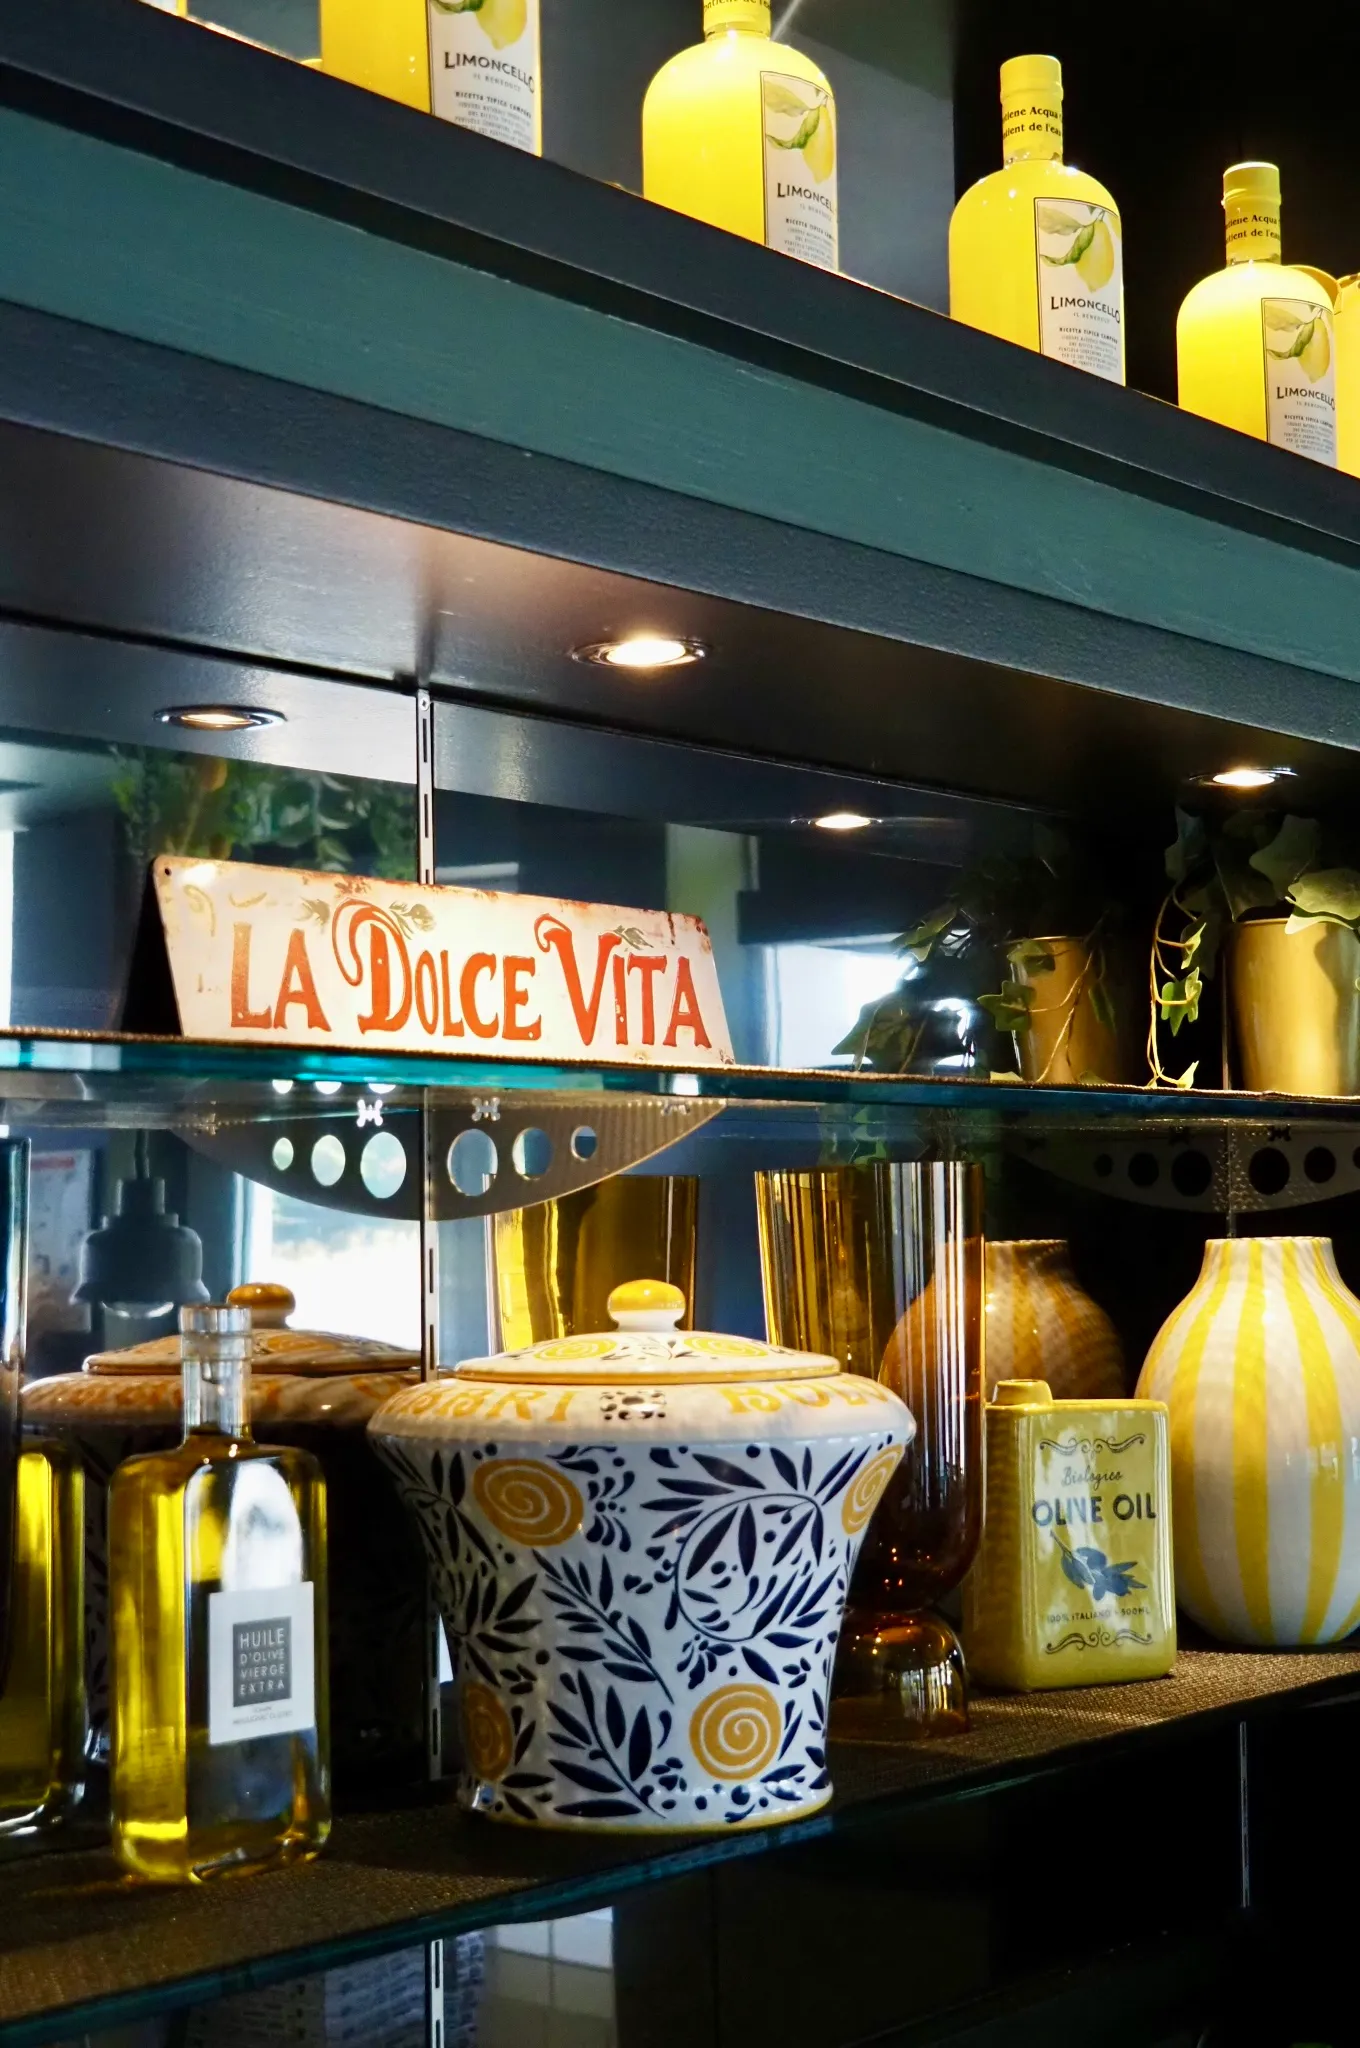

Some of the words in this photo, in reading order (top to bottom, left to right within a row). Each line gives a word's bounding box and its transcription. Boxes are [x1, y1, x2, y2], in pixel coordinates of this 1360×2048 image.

[444, 51, 535, 94] LIMONCELLO
[1030, 106, 1058, 119] Acqua
[1029, 123, 1042, 132] de
[1251, 214, 1277, 225] Acqua
[1251, 229, 1263, 237] de
[1050, 296, 1120, 324] LIMONCELLO
[1276, 386, 1335, 411] LIMONCELLO
[230, 921, 332, 1032] LA
[331, 898, 542, 1042] DOLCE
[534, 913, 712, 1048] VITA
[1032, 1495, 1103, 1527] OLIVE
[1113, 1492, 1157, 1521] OIL
[1072, 1609, 1111, 1621] ITALIANO
[240, 1628, 285, 1649] HUILE
[240, 1648, 285, 1665] D'OLIVE
[240, 1663, 285, 1680] VIERGE
[240, 1679, 285, 1696] EXTRA
